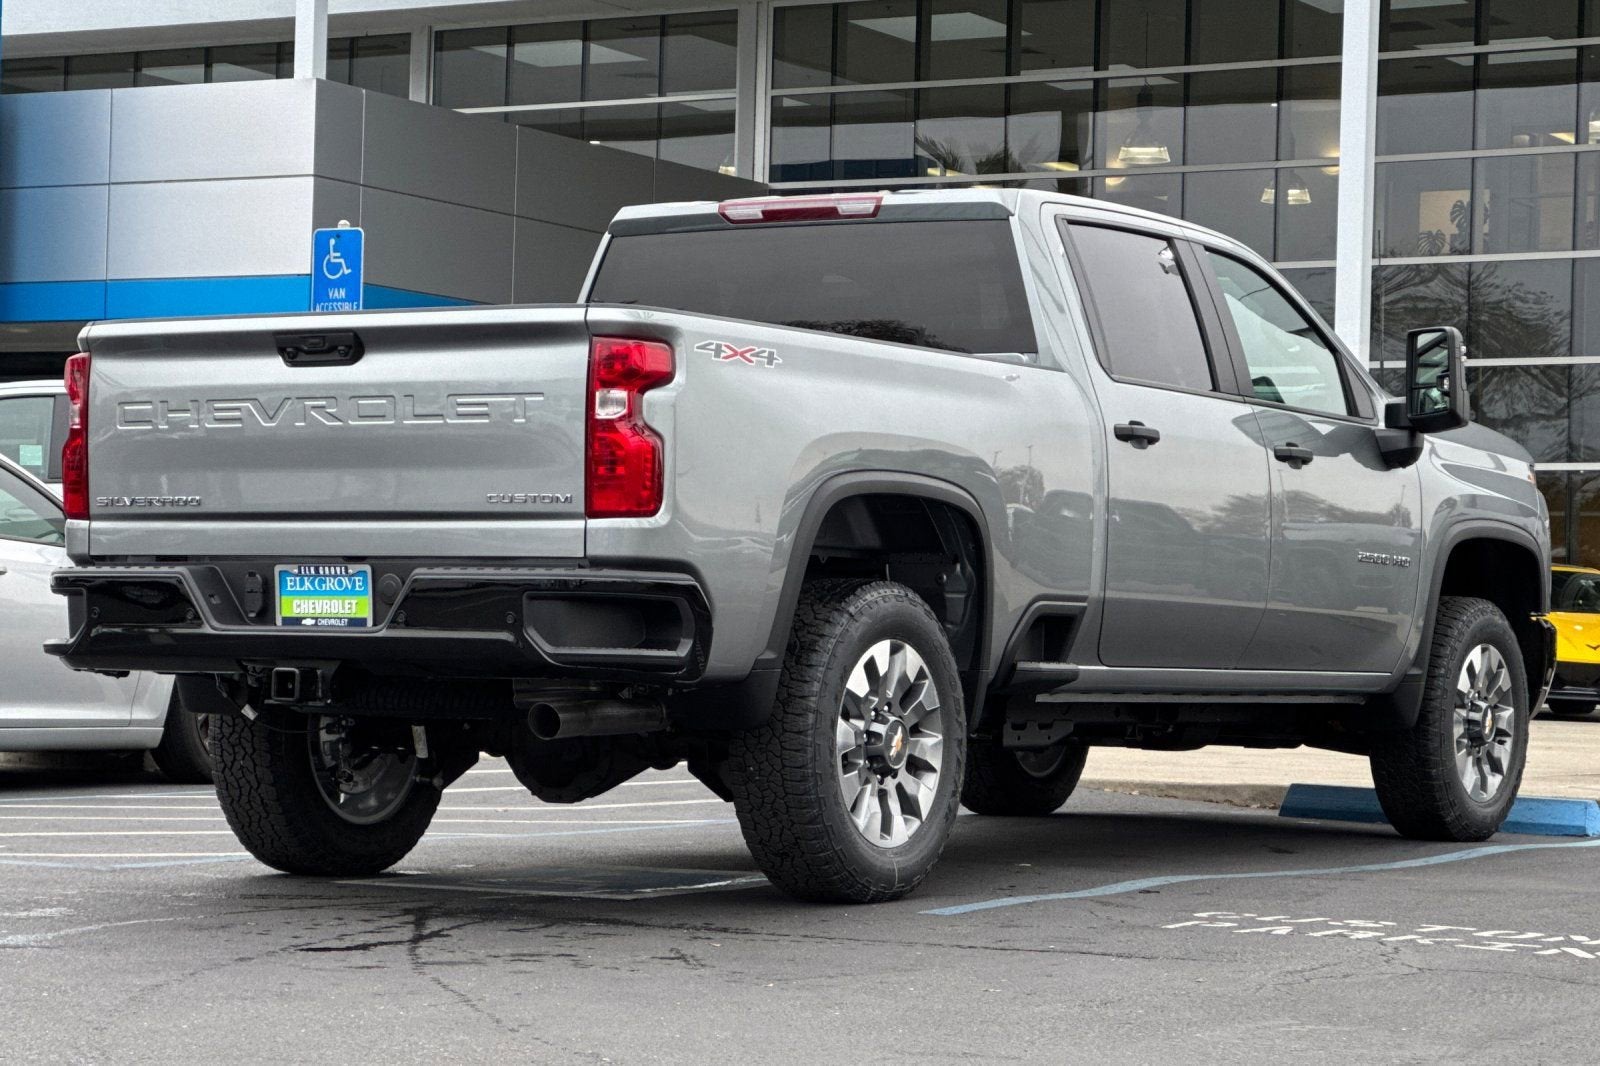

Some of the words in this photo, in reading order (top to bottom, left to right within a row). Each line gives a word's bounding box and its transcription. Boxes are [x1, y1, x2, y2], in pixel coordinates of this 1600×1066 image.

[328, 287, 346, 299] VAN
[315, 301, 358, 312] ACCESSIBLE
[116, 392, 545, 430] CHEVROLET
[96, 495, 202, 507] SILVERADO
[486, 493, 573, 504] CUSTOM
[300, 566, 316, 575] ELK
[319, 566, 346, 575] GROVE
[286, 576, 315, 592] ELK
[315, 576, 365, 592] GROVE
[293, 599, 358, 615] CHEVROLET
[317, 618, 349, 627] CHEVROLET
